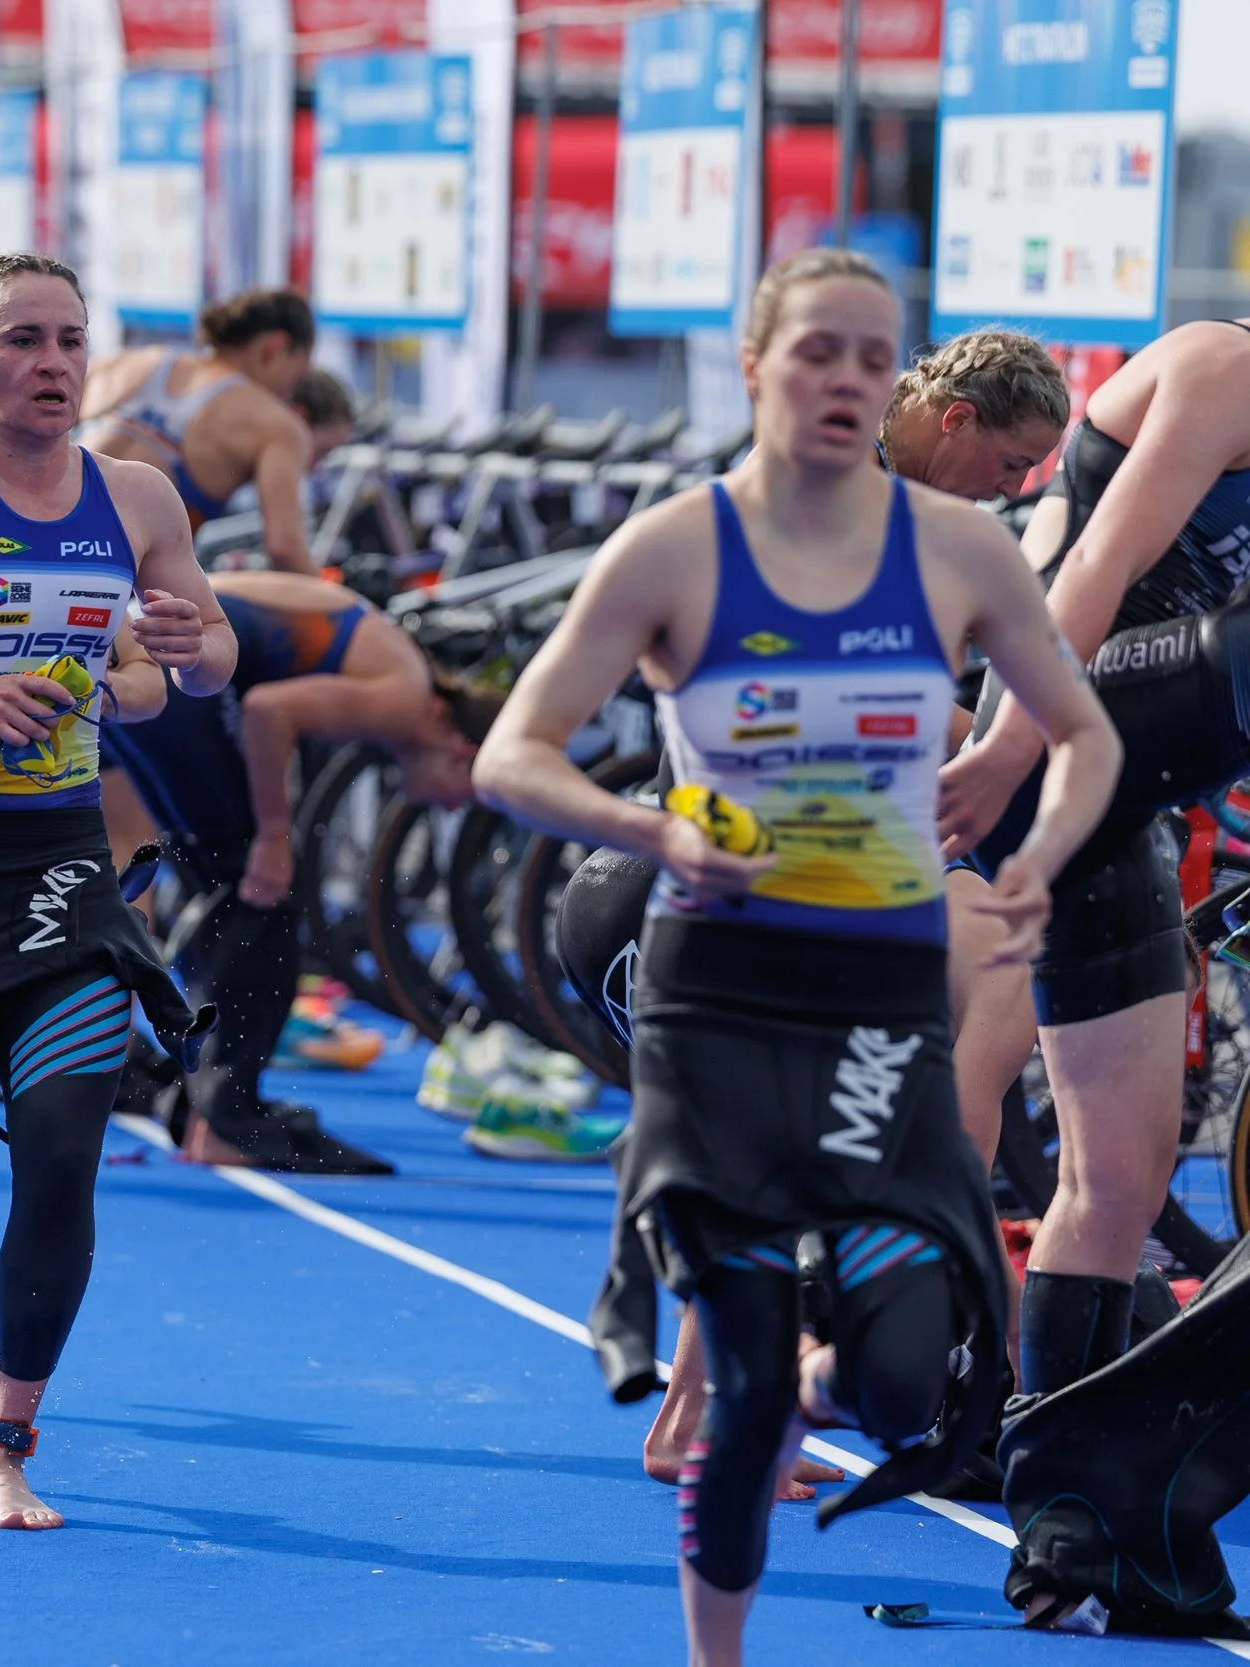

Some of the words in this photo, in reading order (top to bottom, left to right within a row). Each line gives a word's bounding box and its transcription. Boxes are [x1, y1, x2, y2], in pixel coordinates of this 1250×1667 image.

[60, 541, 113, 557] POLI
[59, 590, 120, 600] LAPIERRE
[75, 613, 104, 623] ZEFAL
[839, 625, 913, 655] POLI
